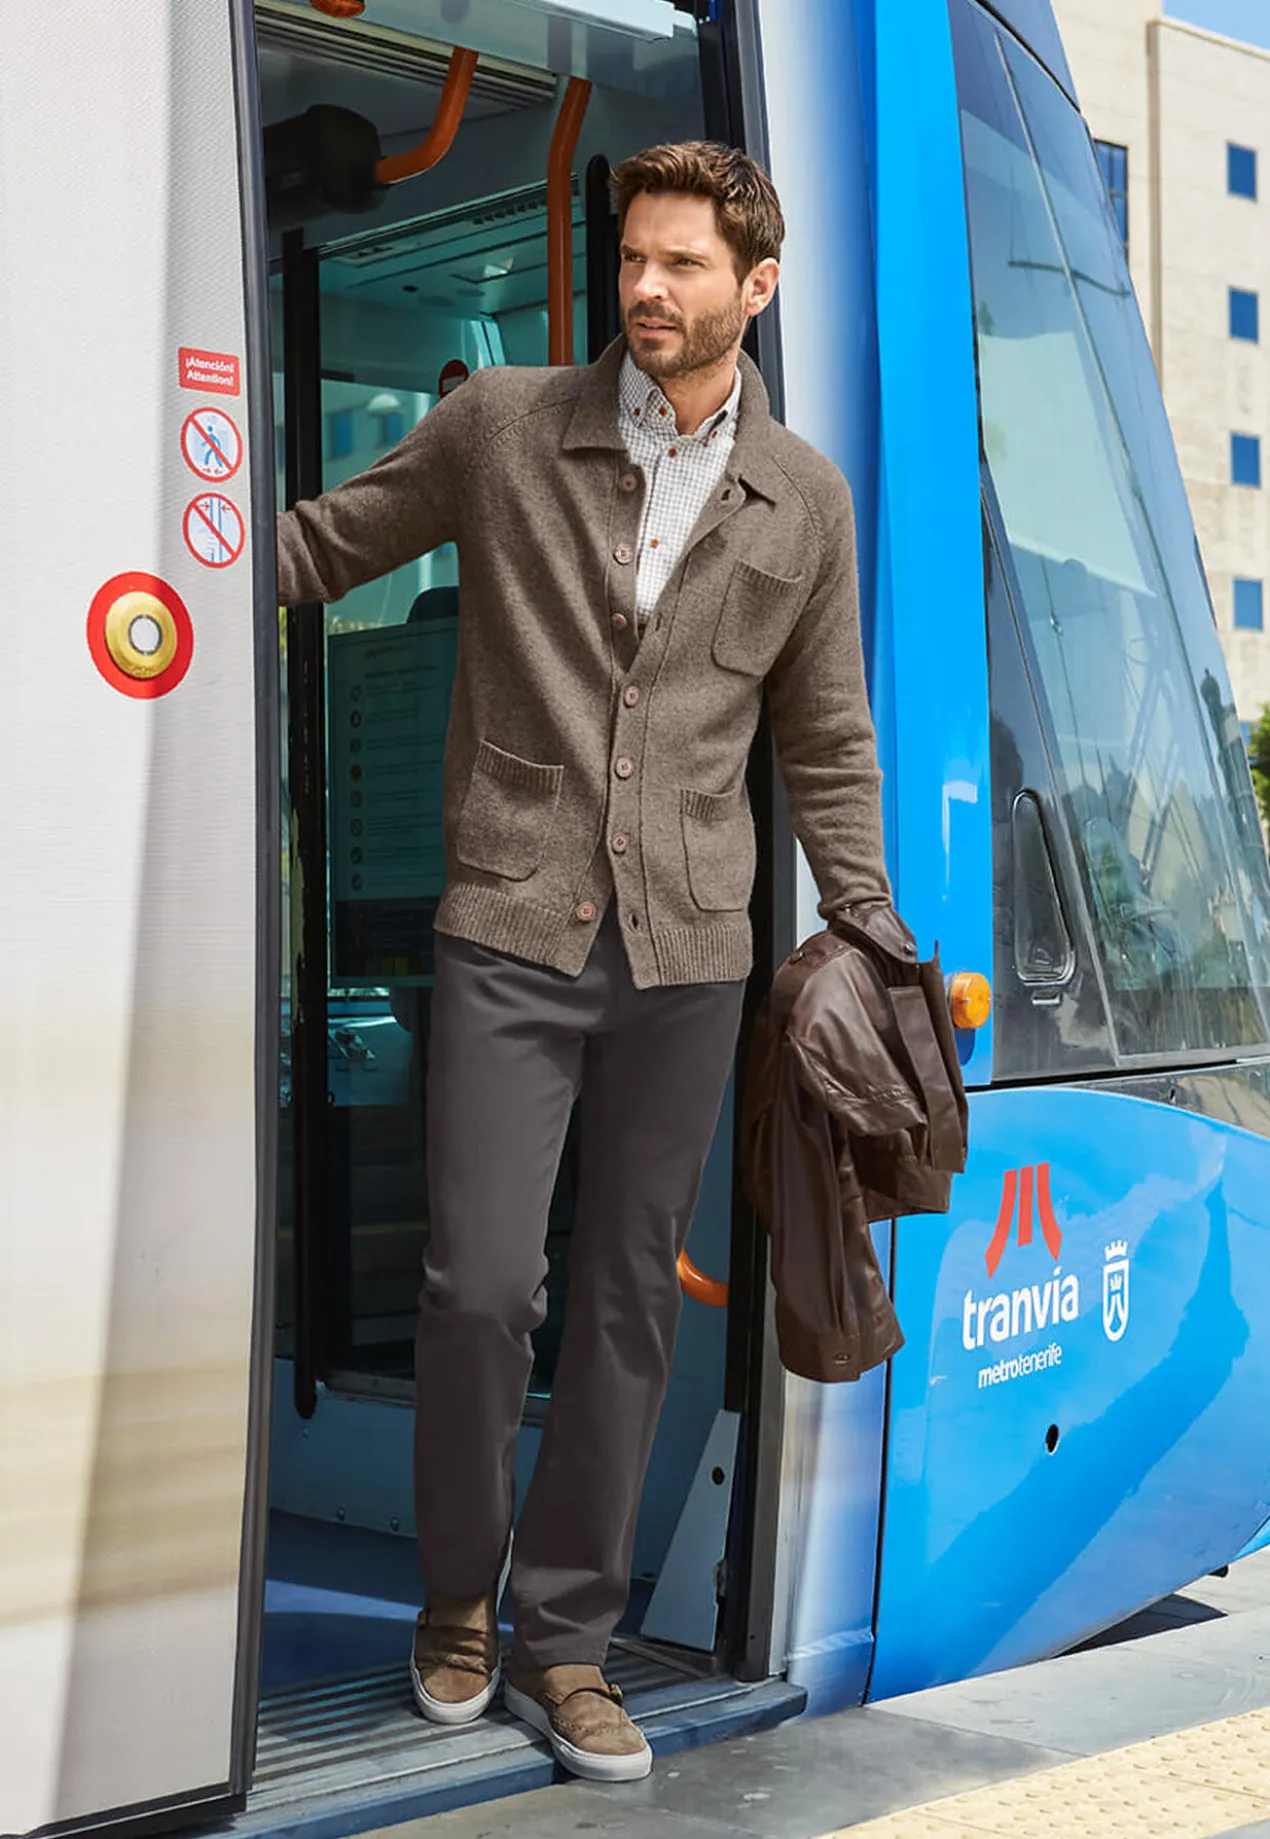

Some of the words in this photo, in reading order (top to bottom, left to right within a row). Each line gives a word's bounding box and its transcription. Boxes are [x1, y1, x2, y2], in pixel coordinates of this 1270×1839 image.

[186, 369, 233, 386] Attention!
[963, 1266, 1079, 1350] tranvía
[978, 1343, 1062, 1389] metrotenerife
